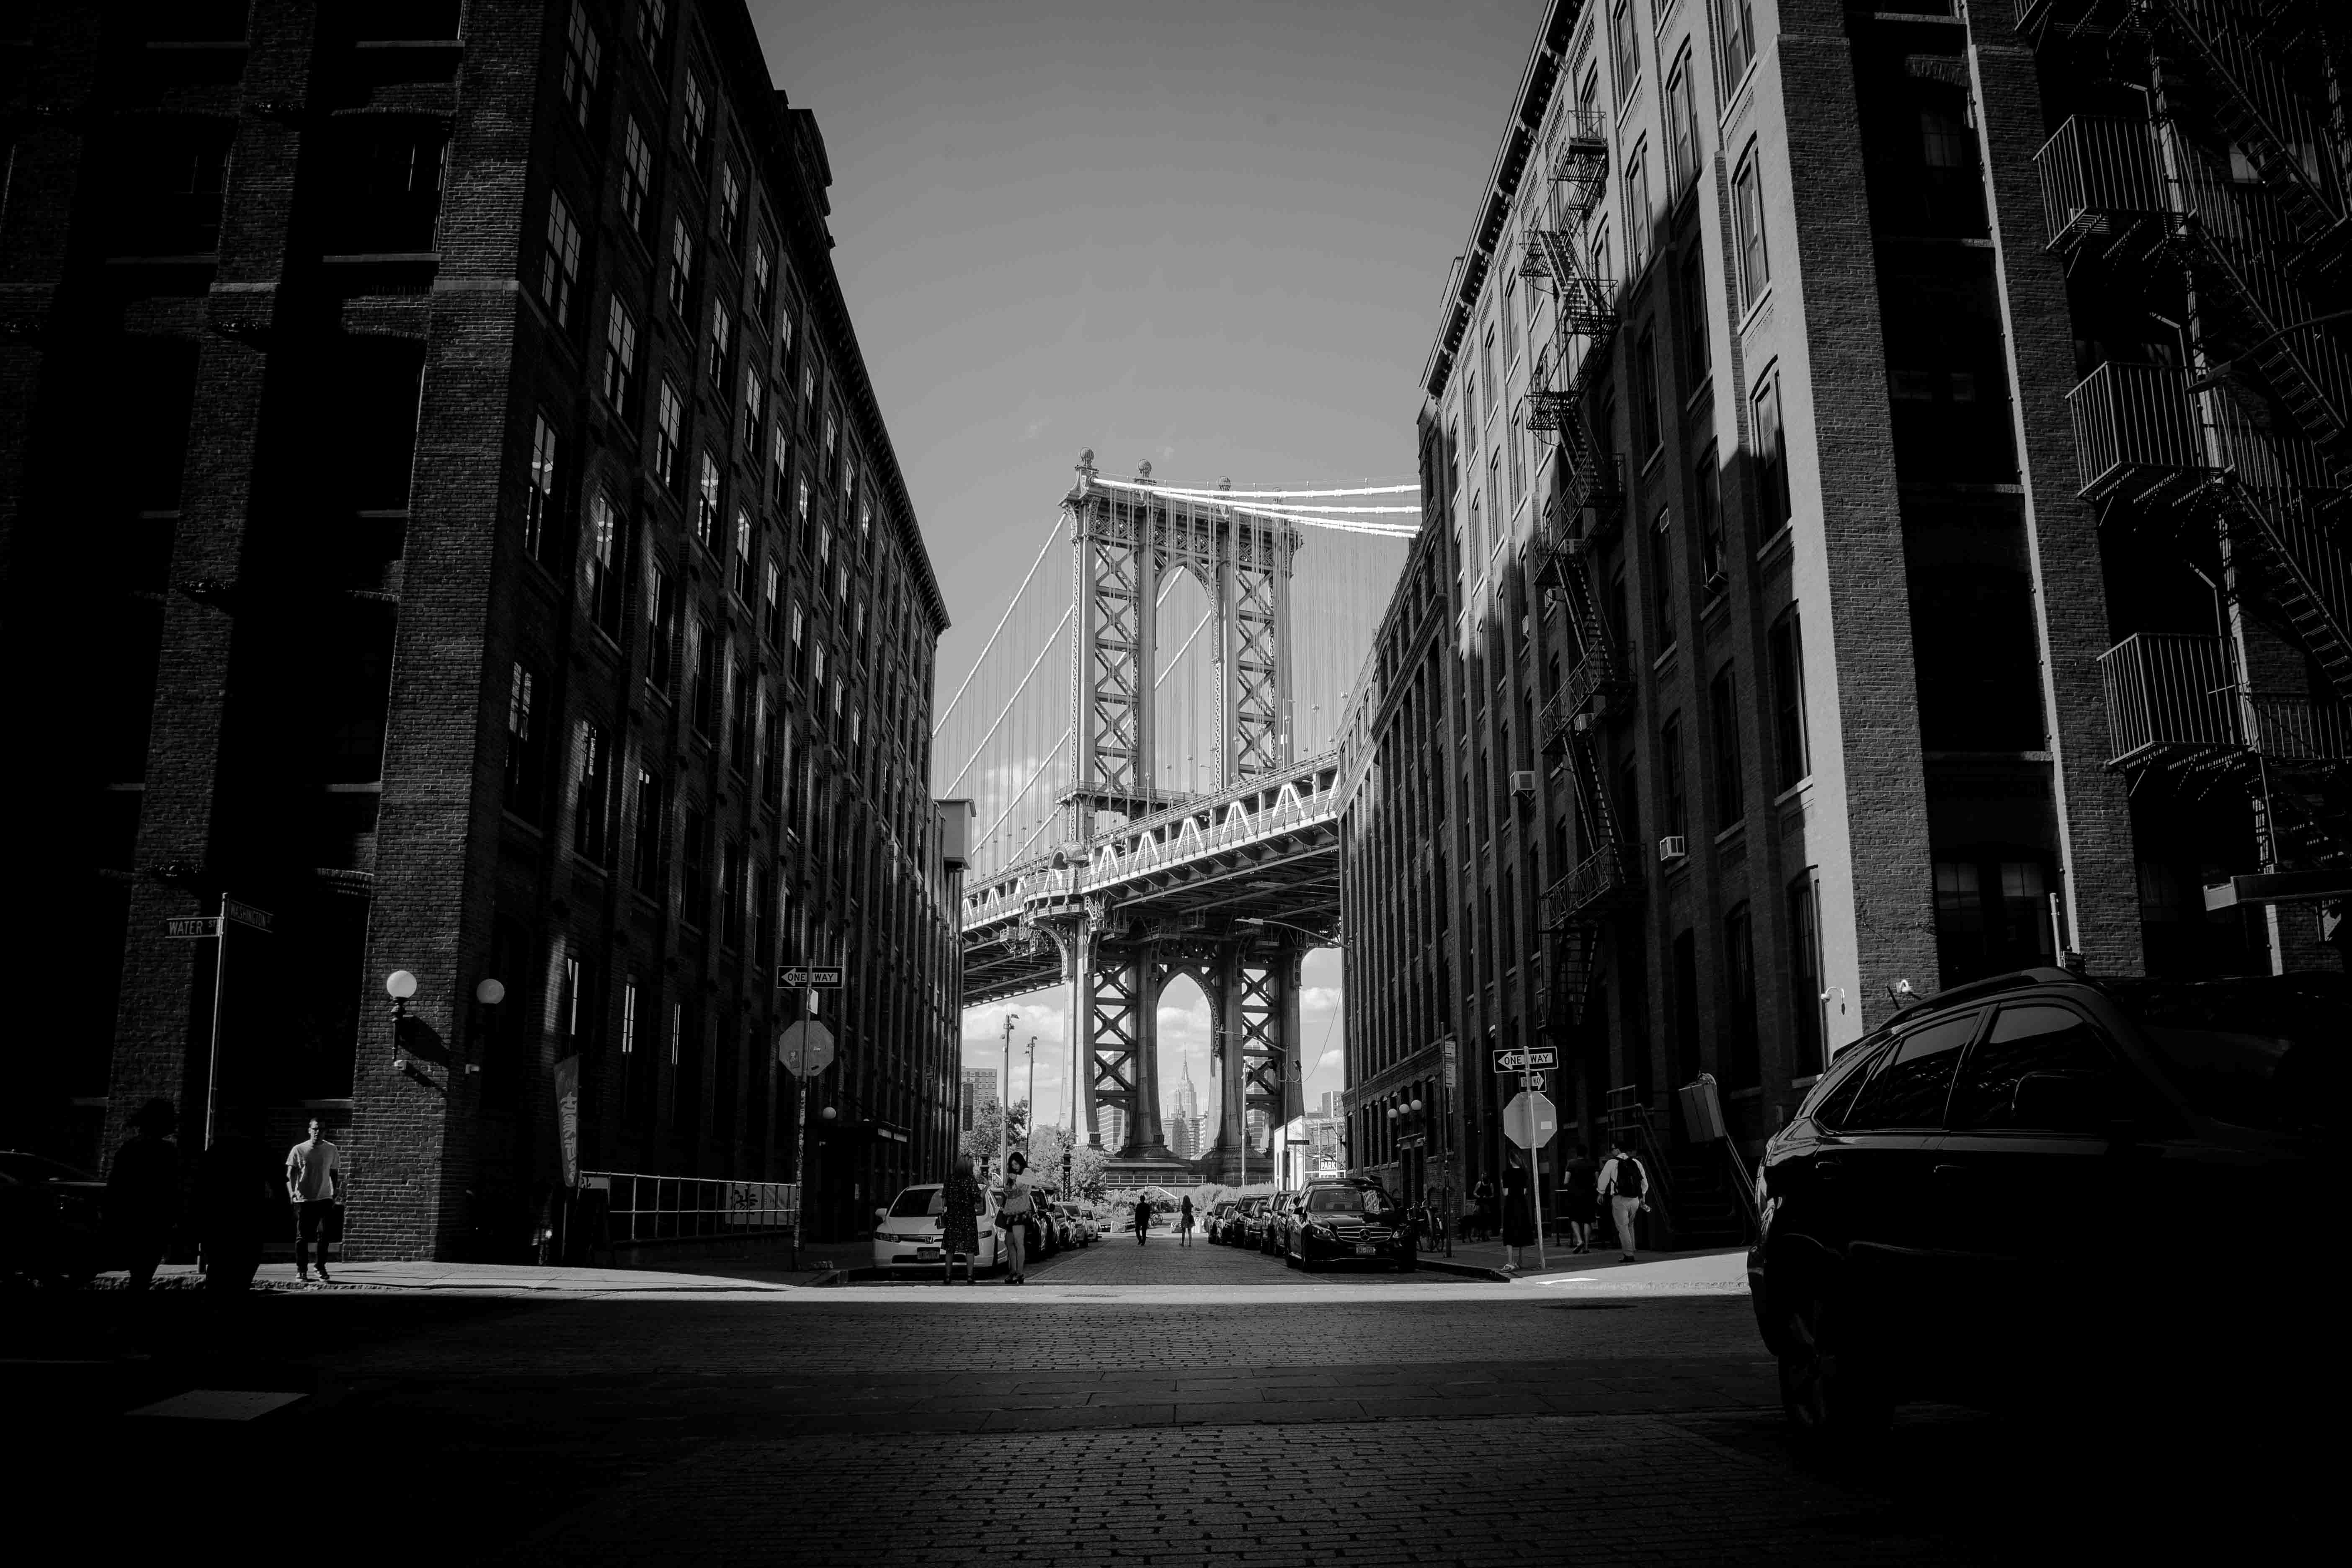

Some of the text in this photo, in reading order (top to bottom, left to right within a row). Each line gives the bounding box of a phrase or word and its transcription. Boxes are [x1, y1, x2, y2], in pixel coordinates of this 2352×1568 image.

[230, 903, 266, 928] WASHINGTON
[169, 920, 217, 935] WATER ST
[787, 973, 806, 981] ONE
[1504, 1054, 1548, 1065] ONE WAY
[1320, 1161, 1336, 1170] PARK
